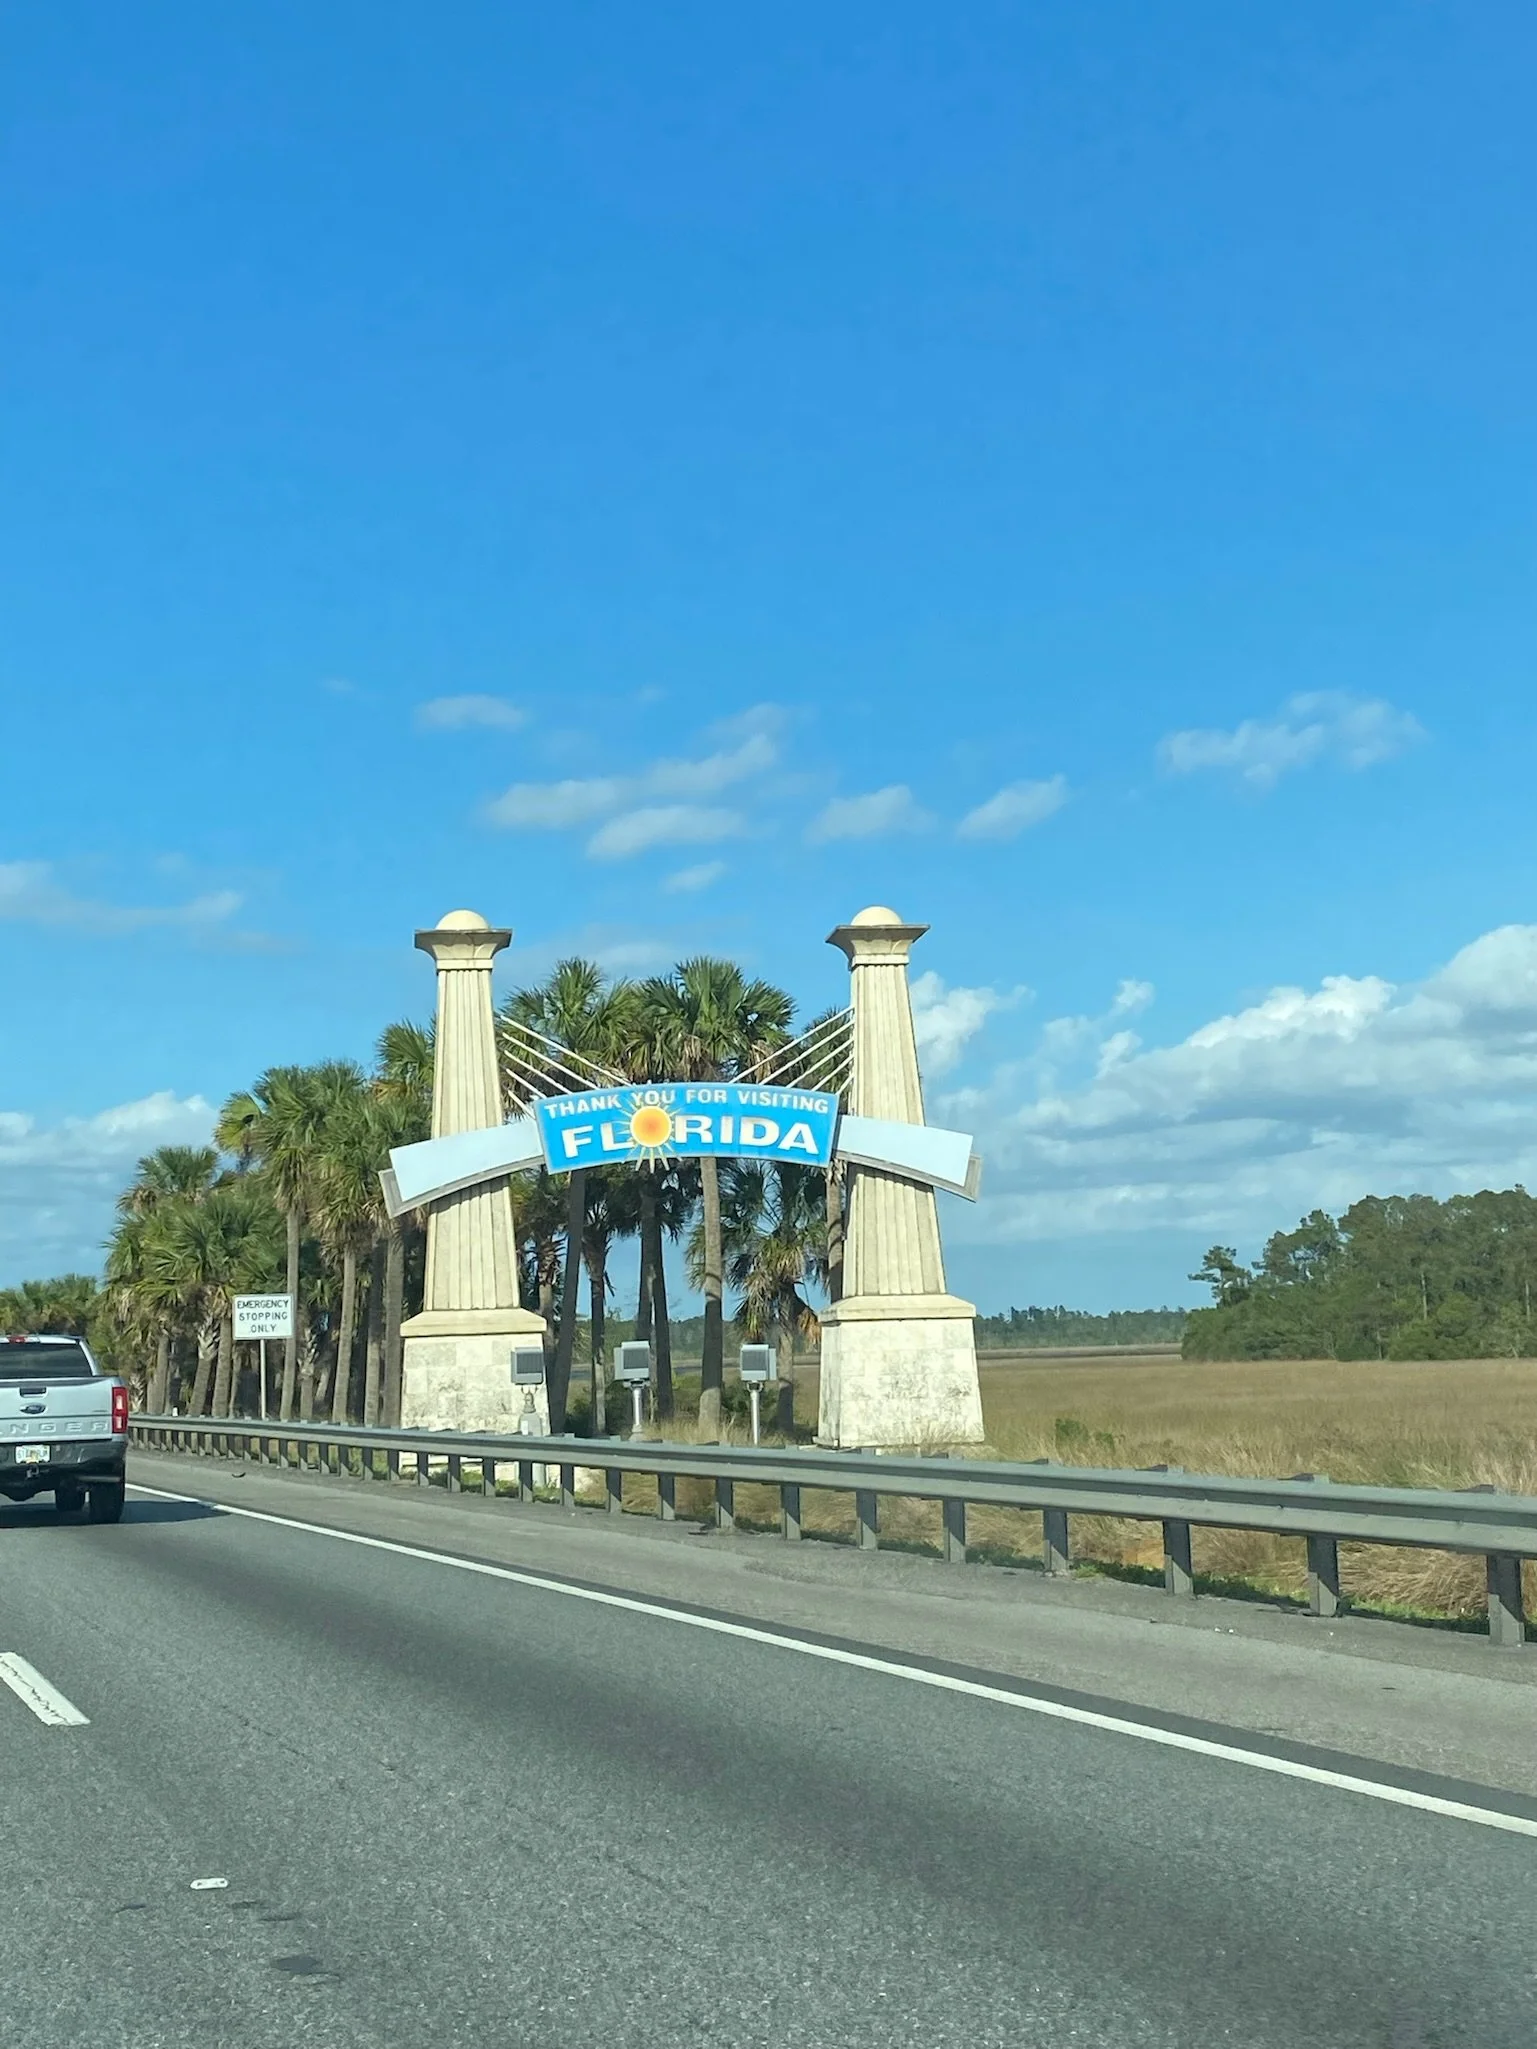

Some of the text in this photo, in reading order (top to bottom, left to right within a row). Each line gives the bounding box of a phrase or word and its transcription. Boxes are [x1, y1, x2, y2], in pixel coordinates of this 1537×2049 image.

[544, 1089, 829, 1119] THANK YOU FOR VISITING
[237, 1299, 289, 1309] EMERGENCY
[239, 1311, 288, 1321] STOPPING
[250, 1324, 277, 1333] ONLY
[0, 1422, 109, 1434] NGER
